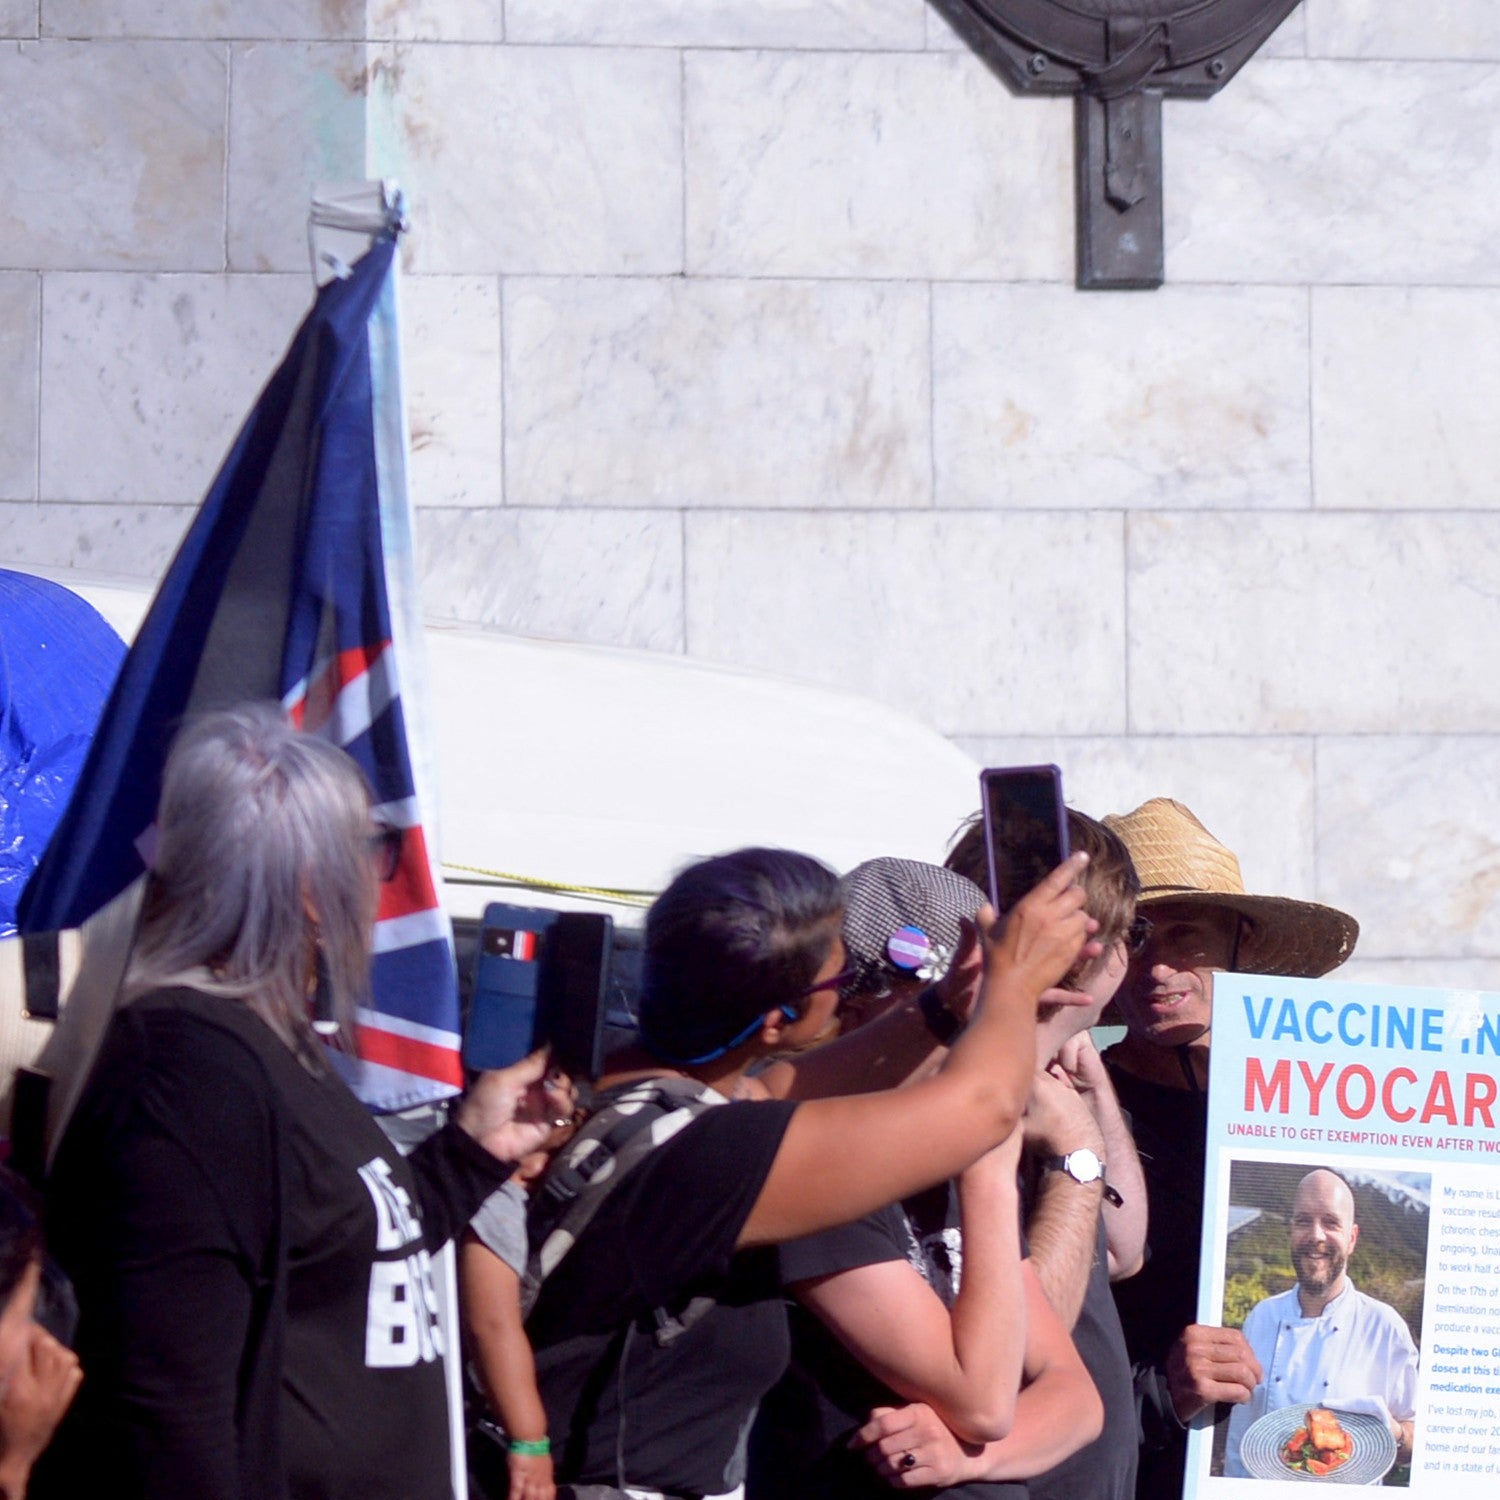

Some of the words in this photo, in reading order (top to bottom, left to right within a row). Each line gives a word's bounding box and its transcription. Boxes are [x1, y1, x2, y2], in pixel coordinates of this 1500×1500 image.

[1242, 996, 1444, 1052] VACCINE
[1228, 1123, 1277, 1138] UNABLE
[1281, 1126, 1296, 1138] TO
[1300, 1128, 1323, 1141] GET
[1327, 1130, 1398, 1146] EXEMPTION
[1402, 1135, 1432, 1148] EVEN
[1437, 1138, 1473, 1151] AFTER
[1444, 1186, 1456, 1199] My
[1459, 1189, 1484, 1199] name
[1486, 1190, 1493, 1199] is
[1442, 1207, 1475, 1216] vaccine
[1441, 1224, 1476, 1236] (chronic
[1439, 1262, 1447, 1271] to
[1450, 1262, 1471, 1272] work
[1475, 1264, 1491, 1273] half
[1438, 1284, 1450, 1294] On
[1453, 1285, 1466, 1295] the
[1470, 1286, 1486, 1297] 17th
[1490, 1288, 1498, 1298] of
[1436, 1303, 1486, 1315] termination
[1434, 1322, 1471, 1333] produce
[1474, 1324, 1478, 1333] a
[1433, 1345, 1469, 1356] Despite
[1472, 1347, 1489, 1357] two
[1432, 1364, 1458, 1374] doses
[1462, 1365, 1471, 1374] at
[1474, 1365, 1490, 1375] this
[1430, 1383, 1482, 1394] medication
[1446, 1406, 1462, 1415] lost
[1465, 1408, 1478, 1419] my
[1480, 1409, 1496, 1419] job,
[1427, 1425, 1454, 1434] career
[1457, 1425, 1466, 1434] of
[1468, 1427, 1487, 1436] over
[1425, 1441, 1450, 1452] home
[1452, 1444, 1469, 1453] and
[1424, 1461, 1440, 1470] and
[1443, 1462, 1450, 1471] in
[1453, 1463, 1458, 1471] a
[1461, 1463, 1482, 1472] state
[1485, 1464, 1494, 1473] of
